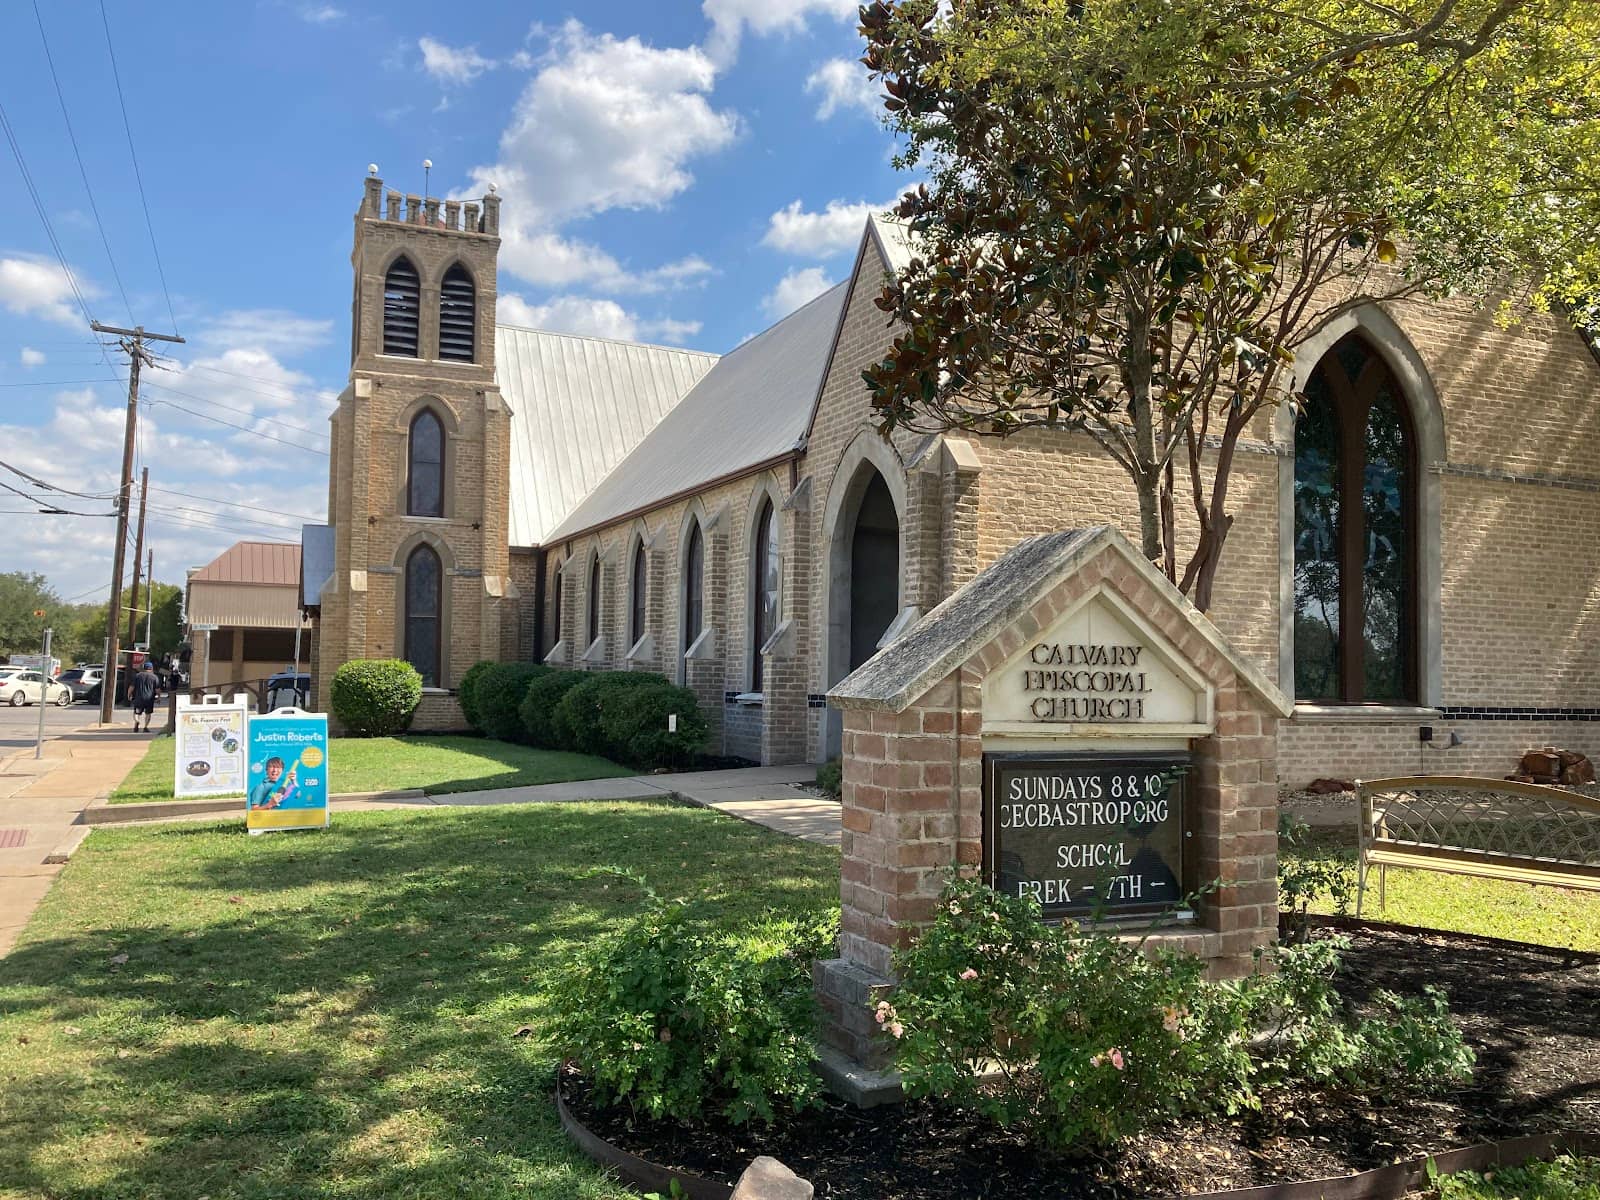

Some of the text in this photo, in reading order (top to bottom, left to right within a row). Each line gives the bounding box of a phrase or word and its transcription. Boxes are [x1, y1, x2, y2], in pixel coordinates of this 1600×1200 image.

[1030, 643, 1143, 666] CALVARY
[1024, 670, 1153, 693] EPISCOPAL
[1030, 697, 1145, 719] CHURCH
[254, 732, 323, 742] Justin Roberts
[1009, 774, 1162, 800] SUNDAYS 8 & 10
[1056, 843, 1132, 868] SCHOOL
[1018, 879, 1072, 904] PREK
